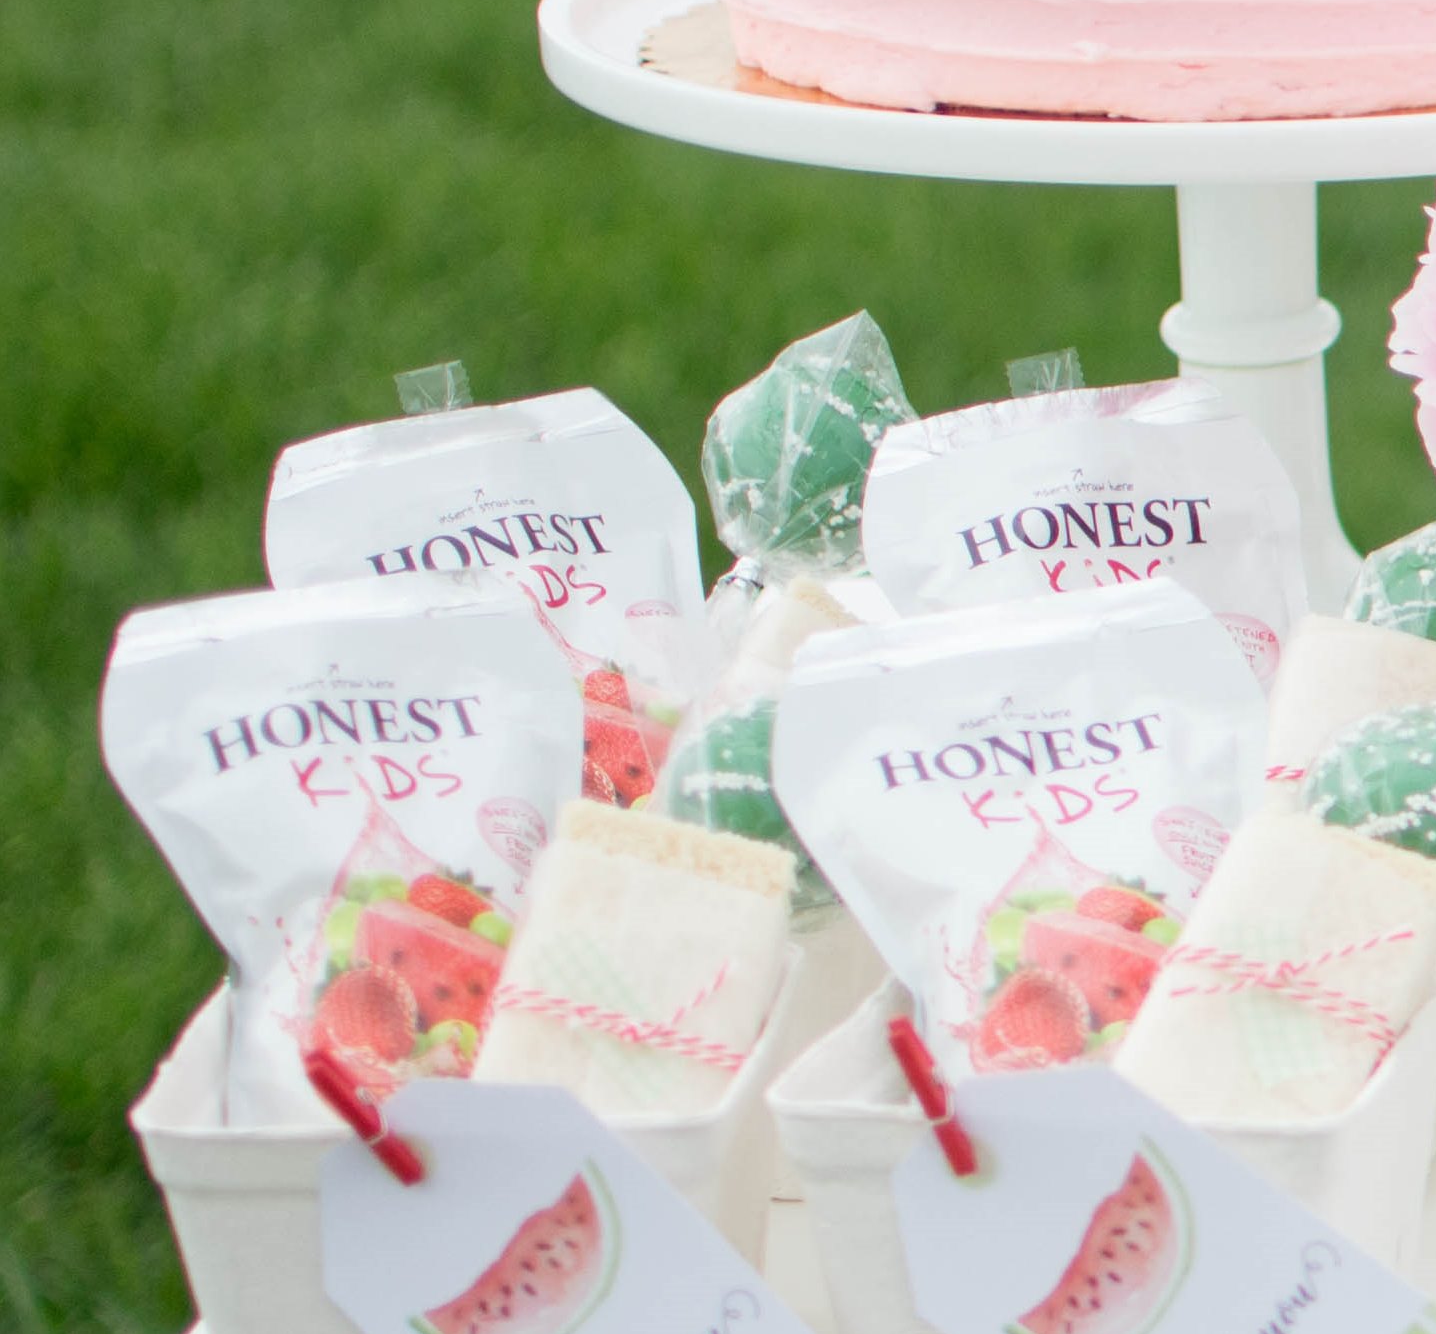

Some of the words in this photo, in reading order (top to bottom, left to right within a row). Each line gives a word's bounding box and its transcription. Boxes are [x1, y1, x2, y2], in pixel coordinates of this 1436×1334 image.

[365, 512, 613, 576] HONEST
[955, 496, 1212, 570] HONEST
[202, 694, 484, 776] HONEST
[872, 712, 1163, 792] HONEST
